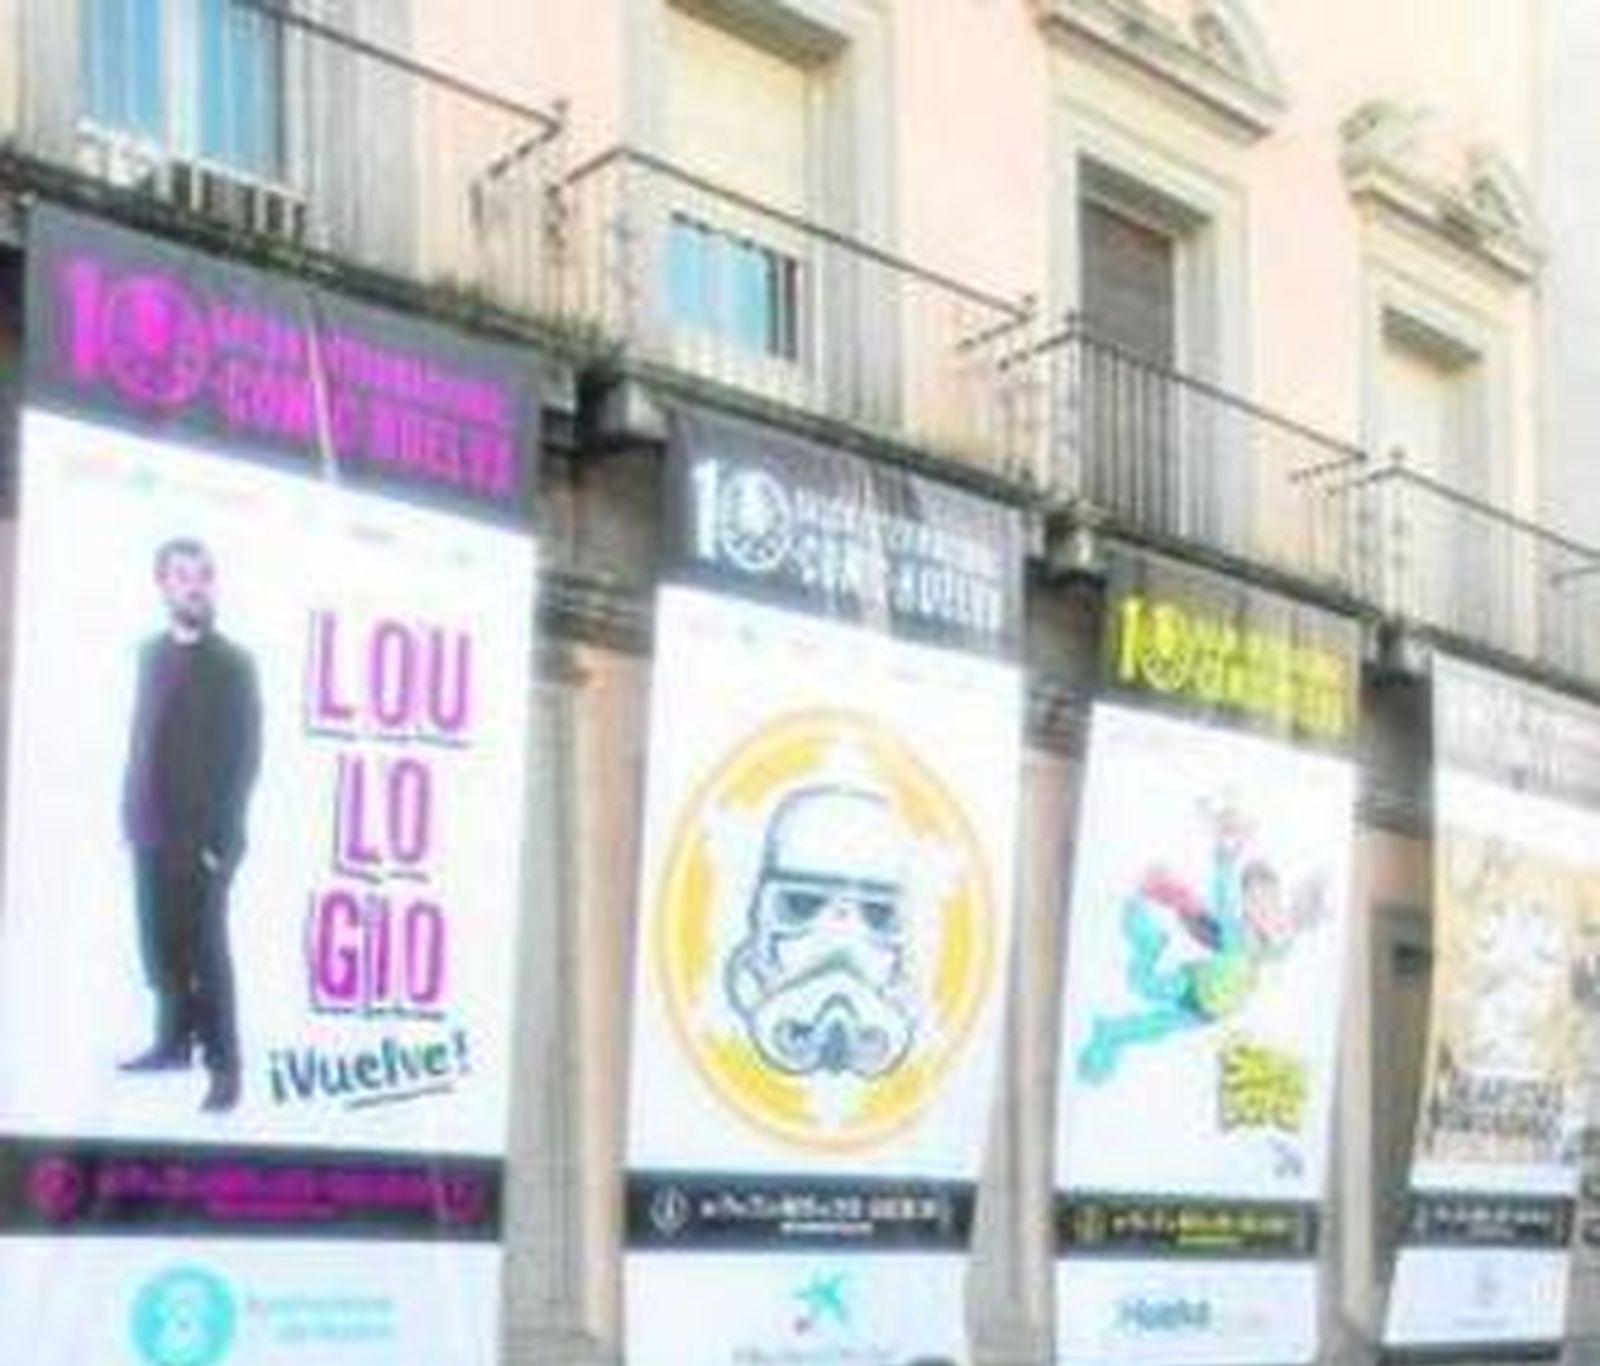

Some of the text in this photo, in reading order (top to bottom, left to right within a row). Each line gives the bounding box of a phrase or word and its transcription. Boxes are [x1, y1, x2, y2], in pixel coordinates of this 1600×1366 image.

[308, 608, 474, 744] LOU
[336, 752, 432, 877] LO
[308, 888, 446, 1014] GIO
